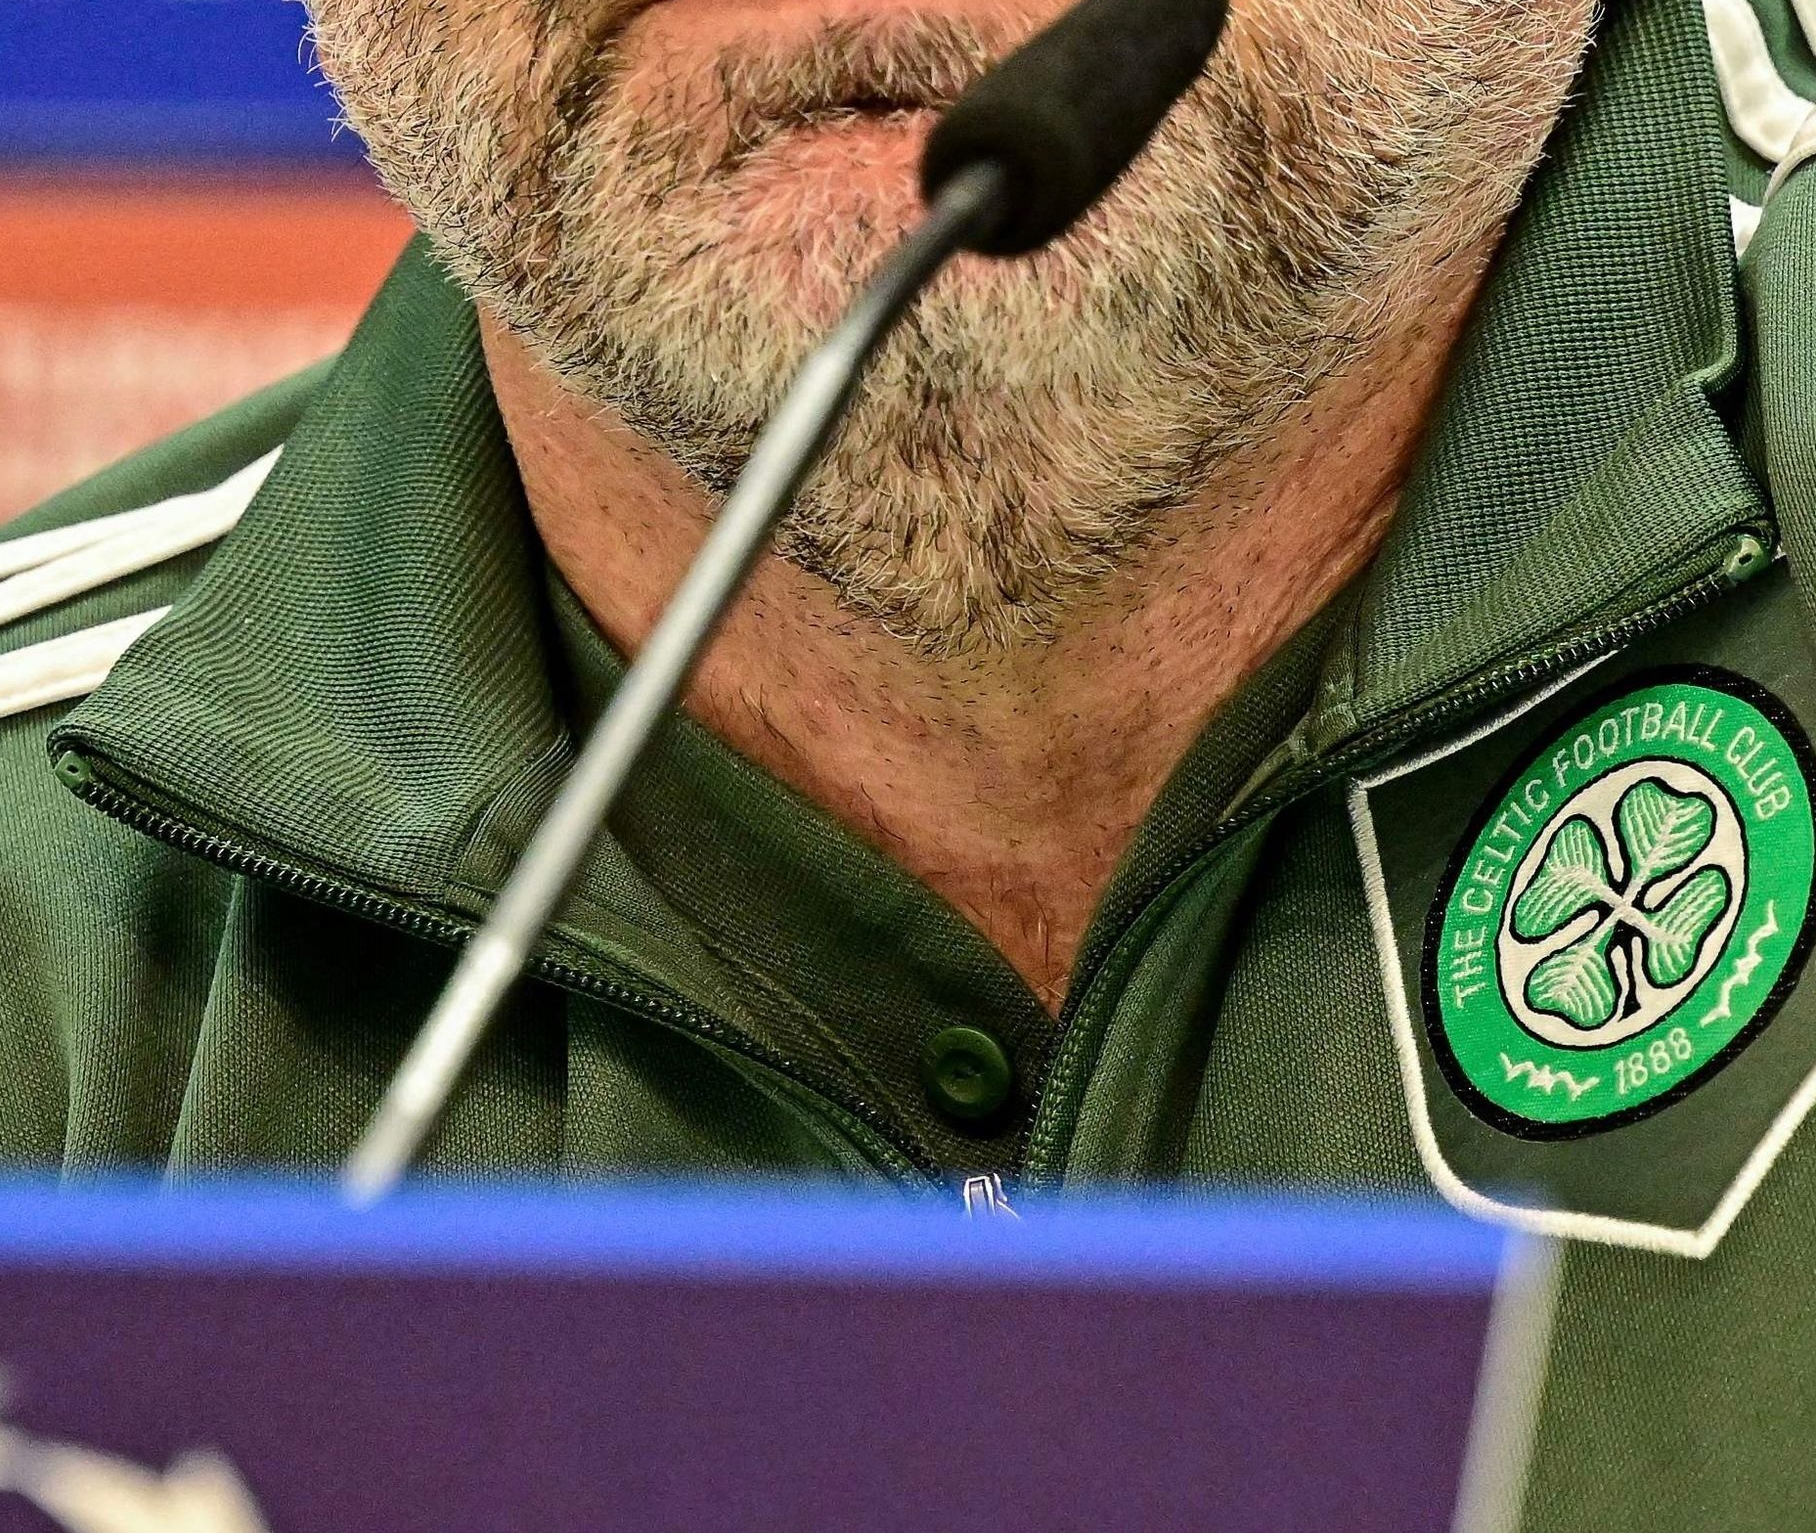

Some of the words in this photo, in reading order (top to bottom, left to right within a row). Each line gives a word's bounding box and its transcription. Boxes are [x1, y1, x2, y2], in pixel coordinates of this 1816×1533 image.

[1552, 700, 1726, 788] FOOTBALL
[1725, 726, 1793, 819] CLUB
[1463, 780, 1550, 913] CELTIC
[1453, 925, 1485, 1009] THE
[1615, 1027, 1692, 1094] 1888
